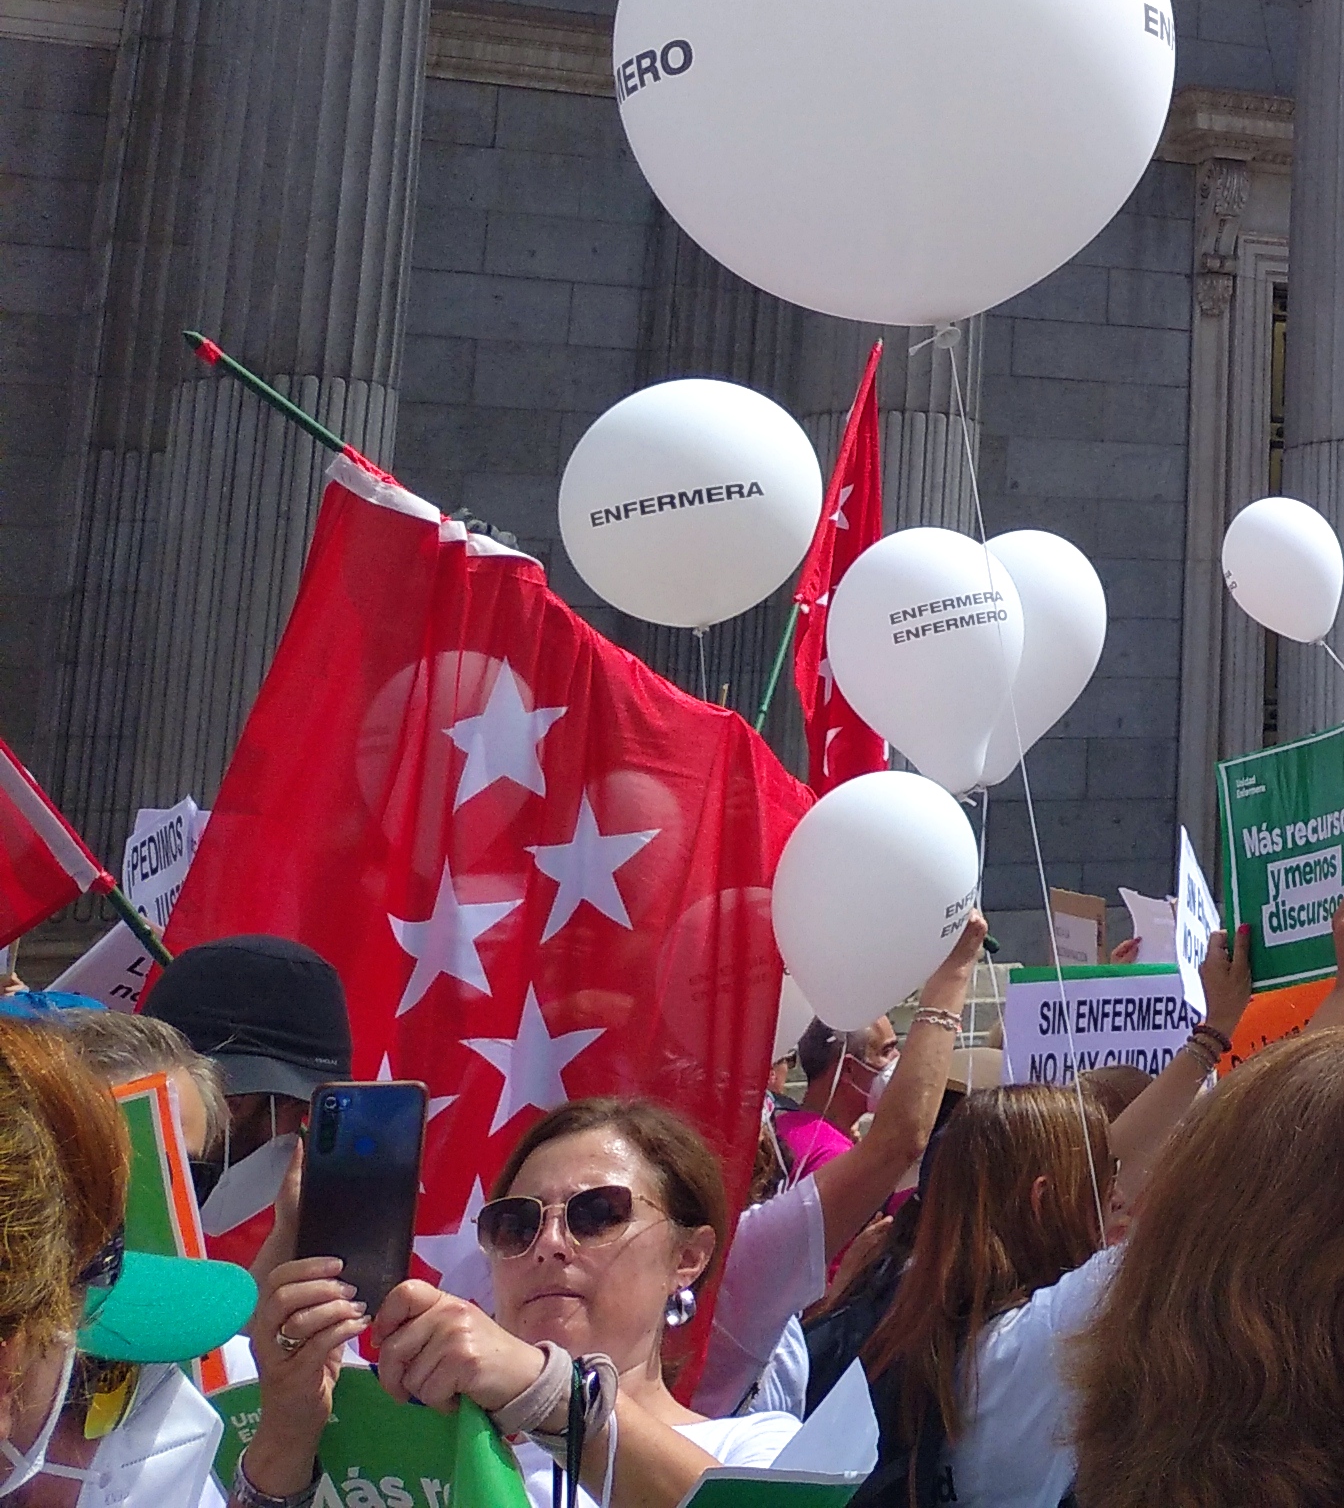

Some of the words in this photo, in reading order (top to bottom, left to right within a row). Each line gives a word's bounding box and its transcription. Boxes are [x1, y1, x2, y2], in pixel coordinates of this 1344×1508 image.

[590, 480, 765, 529] ENFERMERA
[889, 590, 1003, 625] ENFERMERA
[892, 608, 1008, 645] ENFERMERO
[1242, 822, 1283, 859] Más
[1269, 866, 1283, 903] y
[1283, 853, 1338, 890] menos
[1039, 1000, 1070, 1036] SIN
[1075, 995, 1201, 1035] ENFERMERAS
